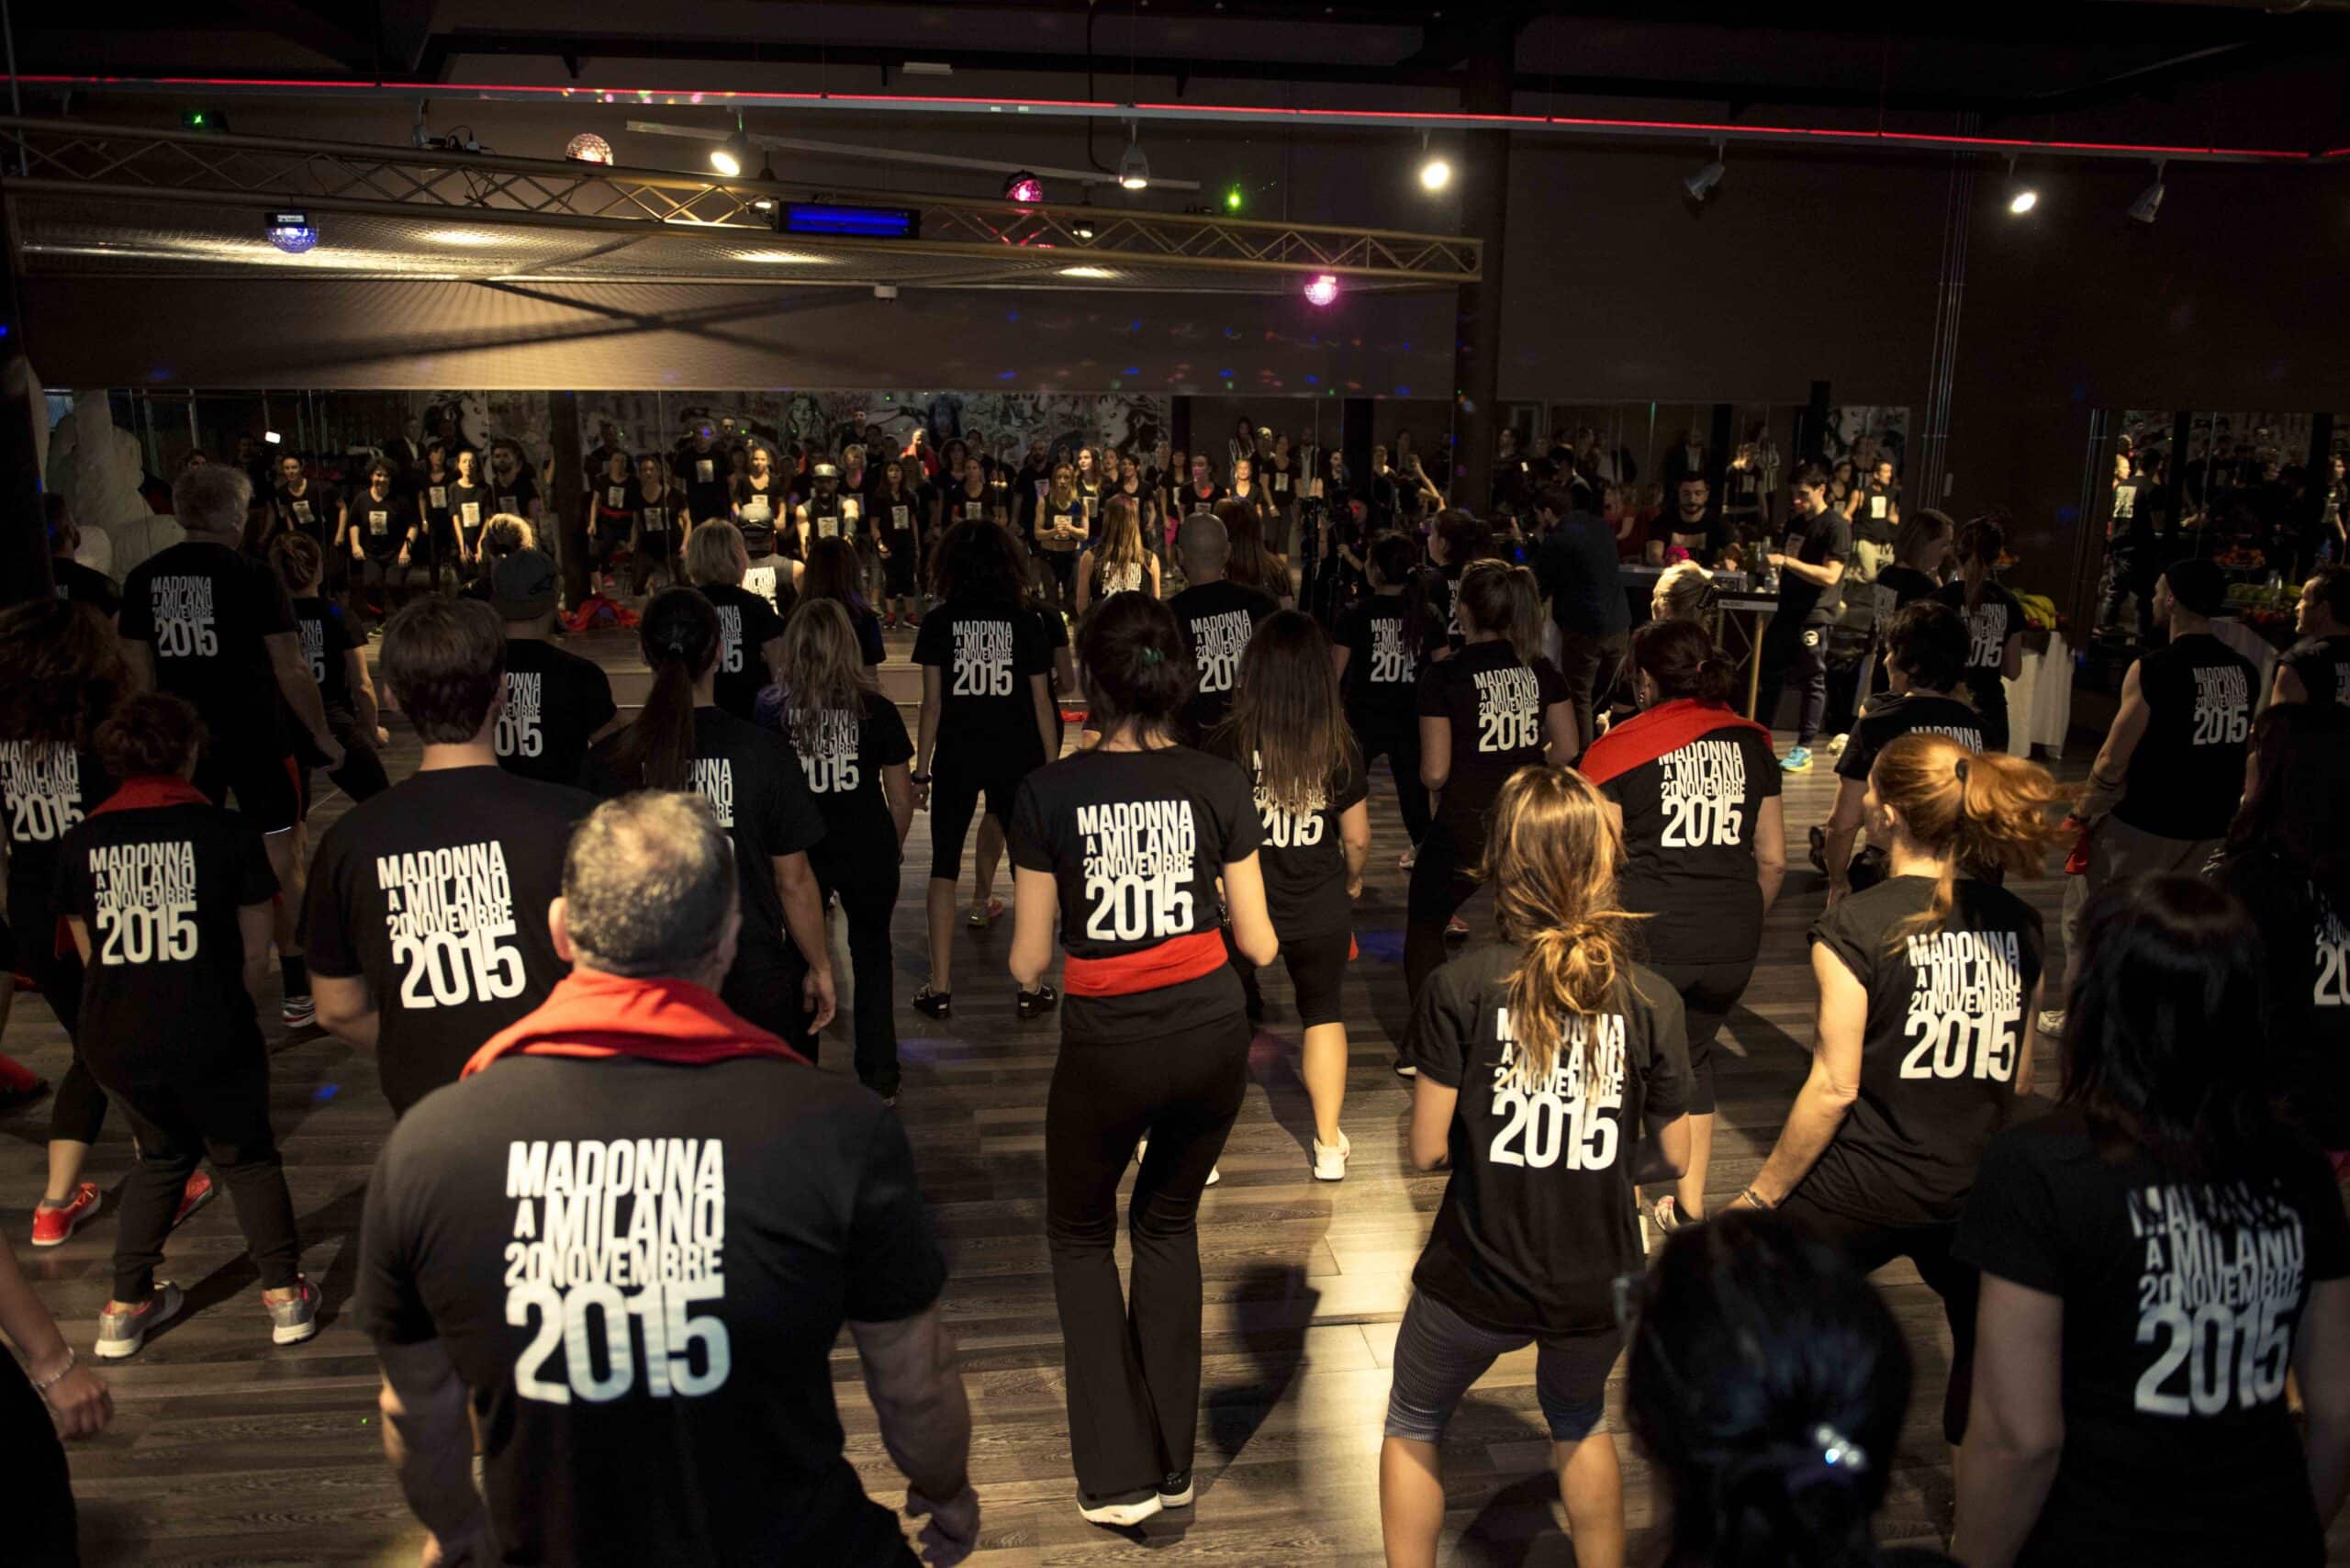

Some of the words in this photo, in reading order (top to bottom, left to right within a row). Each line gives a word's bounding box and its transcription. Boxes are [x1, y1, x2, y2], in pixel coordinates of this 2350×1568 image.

[151, 575, 212, 594] MADONNA
[161, 589, 213, 608] MILANO
[154, 617, 218, 657] 2015
[952, 620, 1013, 637] MADONNA
[1191, 610, 1249, 634] MADONNA
[1196, 633, 1203, 644] A
[1203, 624, 1252, 651] MILANO
[1371, 618, 1403, 633] MADO
[955, 636, 961, 647] A
[964, 633, 1013, 651] MILANO
[1963, 637, 2004, 668] 015
[506, 672, 542, 689] ONNA
[953, 659, 1013, 697] 2015
[1197, 653, 1243, 693] 201
[1472, 666, 1536, 689] MADONNA
[512, 689, 542, 706] ANO
[1480, 689, 1488, 700] A
[1489, 678, 1539, 708] MILANO
[495, 716, 543, 757] 015
[1478, 707, 1539, 753] 2015
[2192, 705, 2248, 745] 2015
[1663, 764, 1673, 780] A
[1675, 757, 1746, 788] MILANO
[4, 792, 85, 842] 2015
[1076, 800, 1194, 836] MADONNA
[1662, 795, 1745, 847] 2015
[89, 840, 196, 873] MADONNA
[1085, 835, 1098, 855] A
[1101, 826, 1195, 859] MILANO
[95, 872, 106, 890] A
[109, 864, 196, 895] MILANO
[376, 840, 507, 890] MADONNA
[387, 889, 403, 912] A
[403, 870, 513, 918] MILANO
[1085, 873, 1194, 941] 2015
[96, 903, 199, 965] 2015
[1907, 931, 2020, 967] MADONNA
[392, 921, 527, 1009] 2015
[1917, 967, 1929, 989] A
[1930, 960, 2021, 994] MILANO
[2313, 939, 2350, 1007] 20
[1501, 1041, 1514, 1066] A
[1899, 1008, 2021, 1082] 2015
[1489, 1090, 1623, 1170] 2015
[506, 1138, 725, 1198] MADONNA
[512, 1197, 538, 1239] A
[543, 1192, 725, 1249] MILANO
[2145, 1237, 2164, 1271] A
[2167, 1208, 2305, 1280] MILANO
[506, 1274, 732, 1405] 2015
[2133, 1300, 2300, 1417] 2015
